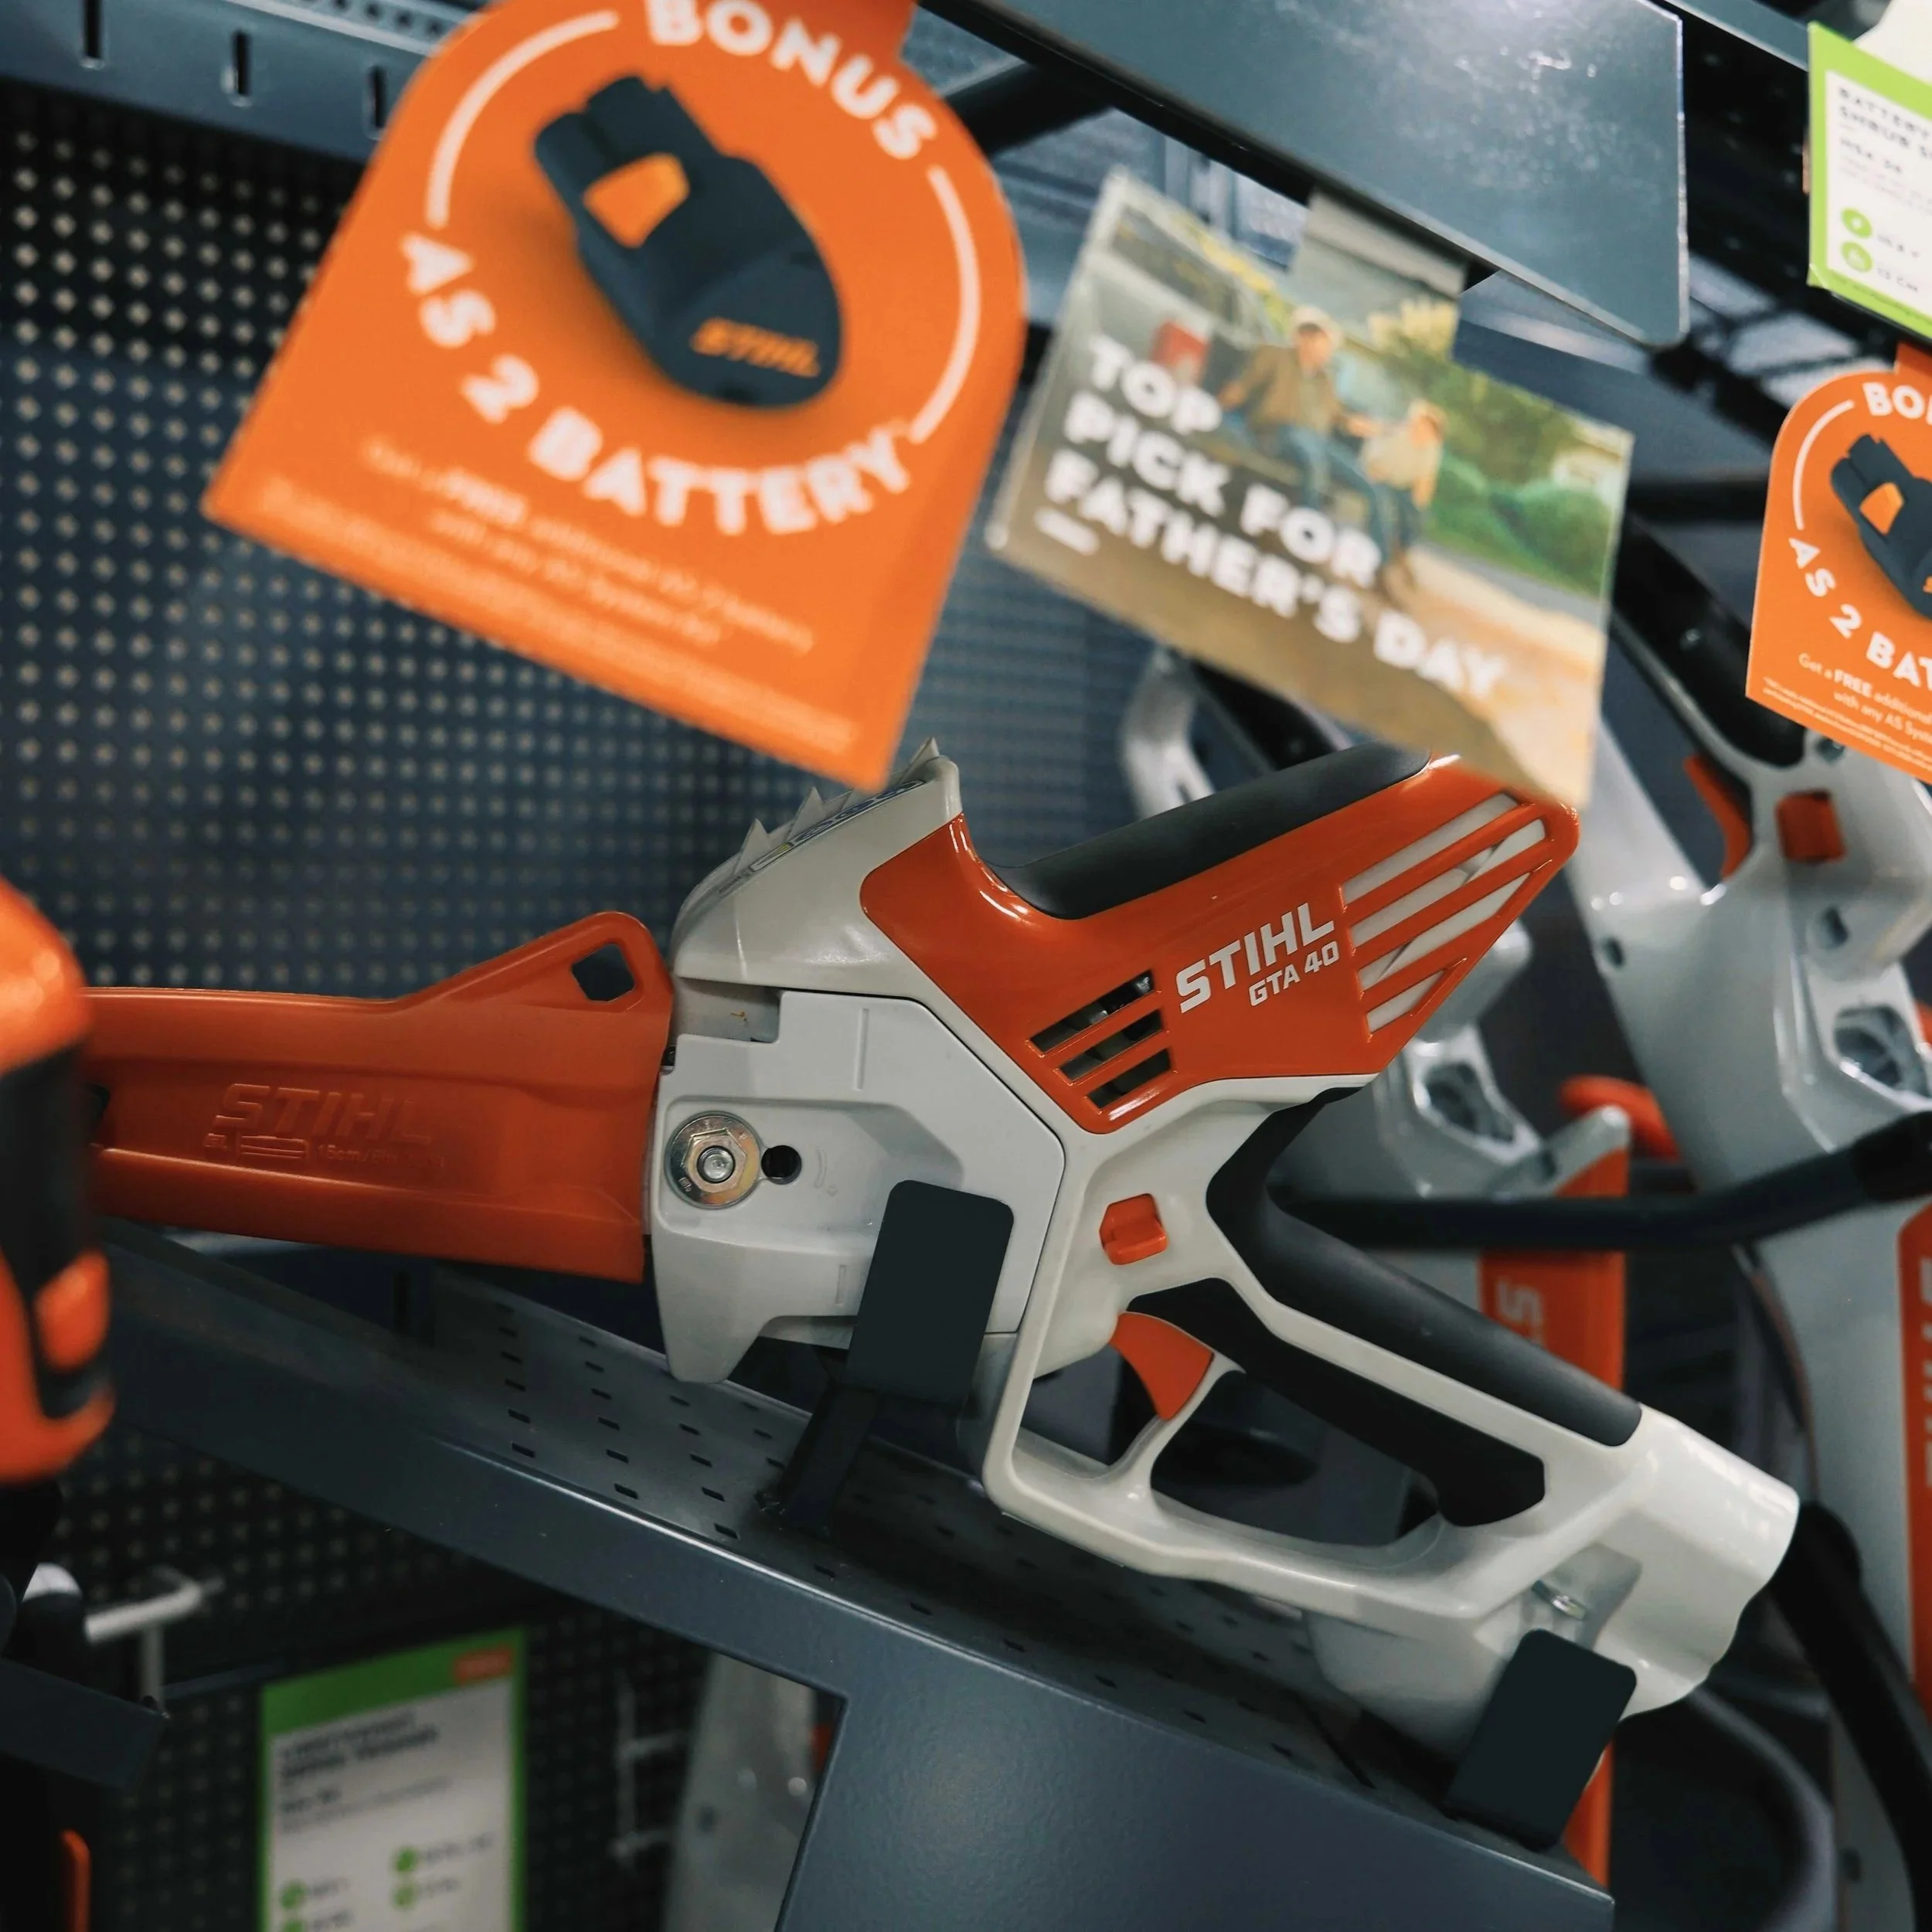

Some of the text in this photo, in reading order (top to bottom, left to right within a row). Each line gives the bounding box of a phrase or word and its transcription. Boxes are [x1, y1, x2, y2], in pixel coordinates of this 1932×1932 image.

[644, 0, 937, 160] BONUS
[401, 233, 495, 349] AS
[461, 354, 540, 424] 2
[528, 407, 910, 536] BATTERY
[690, 317, 820, 378] STIHL
[1088, 334, 1223, 435] TOP
[1862, 382, 1932, 425] BO
[1063, 391, 1383, 589] PICK FOR
[1044, 451, 1509, 699] FATHER'S DAY
[1788, 537, 1837, 597] AS
[1828, 603, 1862, 639] 2
[1798, 653, 1823, 675] Get
[1824, 668, 1832, 679] a
[1834, 668, 1872, 698] FREE
[1833, 692, 1859, 710] with
[1861, 705, 1883, 723] any
[1885, 713, 1903, 730] AS
[1176, 902, 1335, 1013] STIHL
[1249, 940, 1340, 1006] GTA 40
[212, 1083, 433, 1145] STIHL
